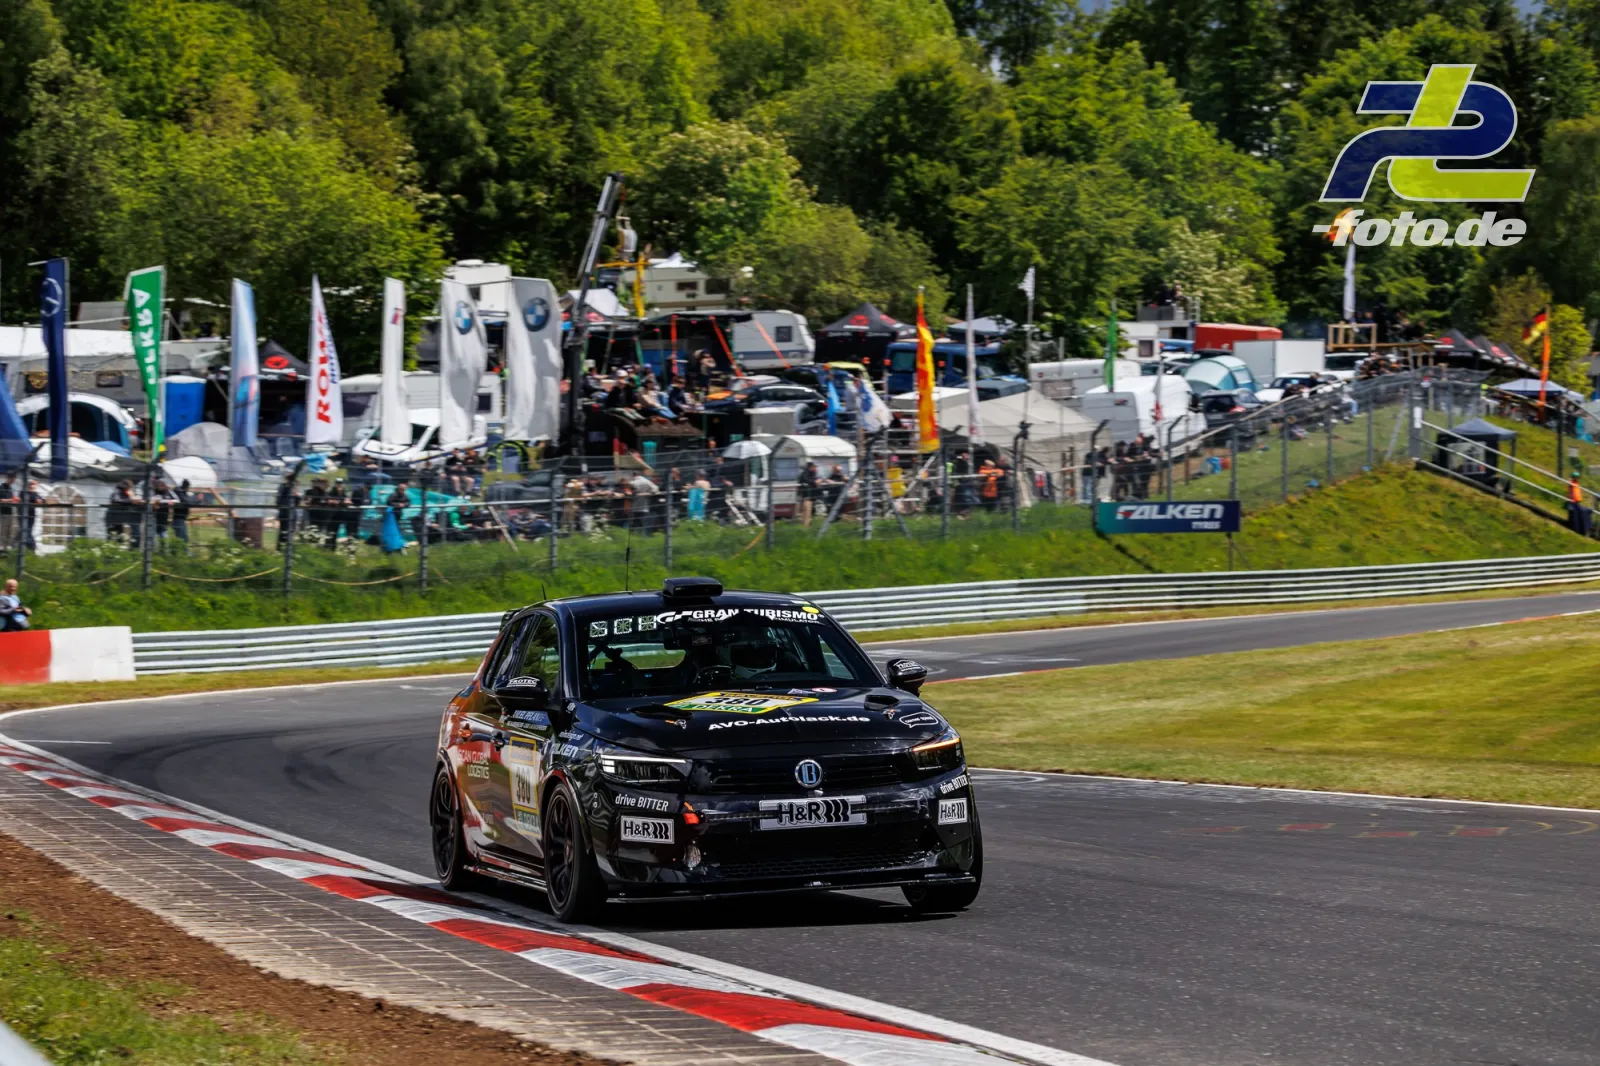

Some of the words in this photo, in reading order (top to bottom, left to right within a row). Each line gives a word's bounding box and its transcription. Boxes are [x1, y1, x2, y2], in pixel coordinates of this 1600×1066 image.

[1115, 504, 1224, 520] FALKEN
[692, 608, 739, 621] GRAN
[691, 704, 753, 713] DEKRA
[705, 697, 770, 706] 380
[708, 715, 871, 731] AVO-Autolack.de
[515, 766, 531, 805] 380
[615, 794, 636, 807] drive
[637, 796, 669, 812] BITTER
[778, 801, 827, 825] H&R
[624, 821, 656, 840] H&R
